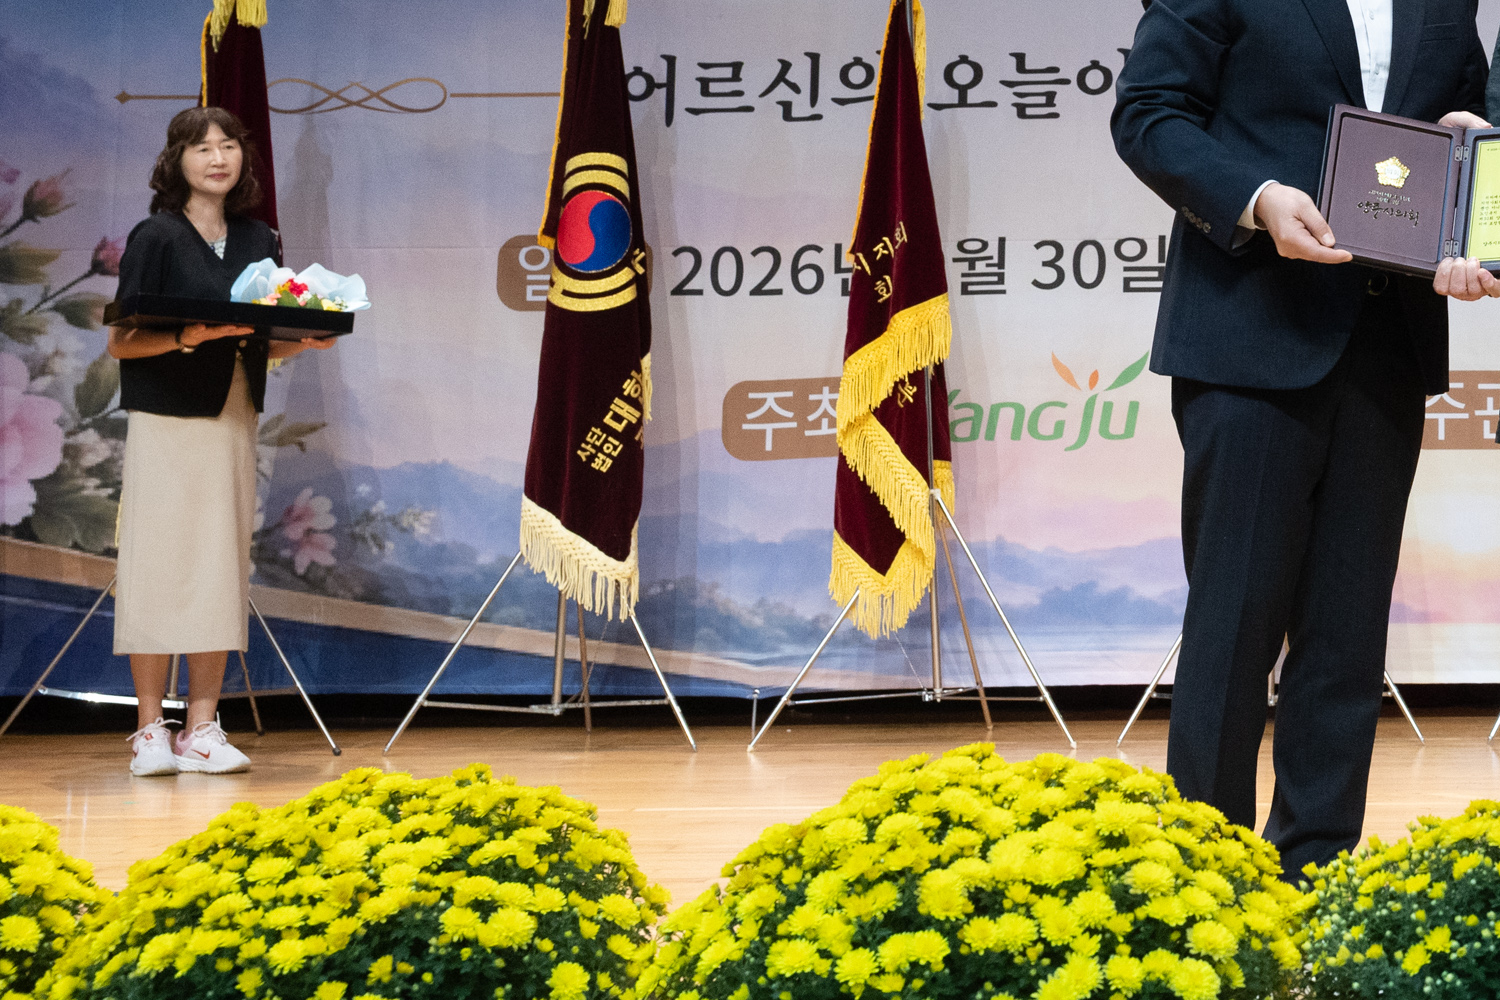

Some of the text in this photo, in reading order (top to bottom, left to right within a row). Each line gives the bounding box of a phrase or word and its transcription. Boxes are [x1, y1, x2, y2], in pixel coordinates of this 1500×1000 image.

[1357, 201, 1419, 228] 양주시의회
[518, 245, 551, 301] 일
[952, 236, 1006, 296] 월
[577, 427, 606, 461] 사단
[591, 437, 623, 473] 법인
